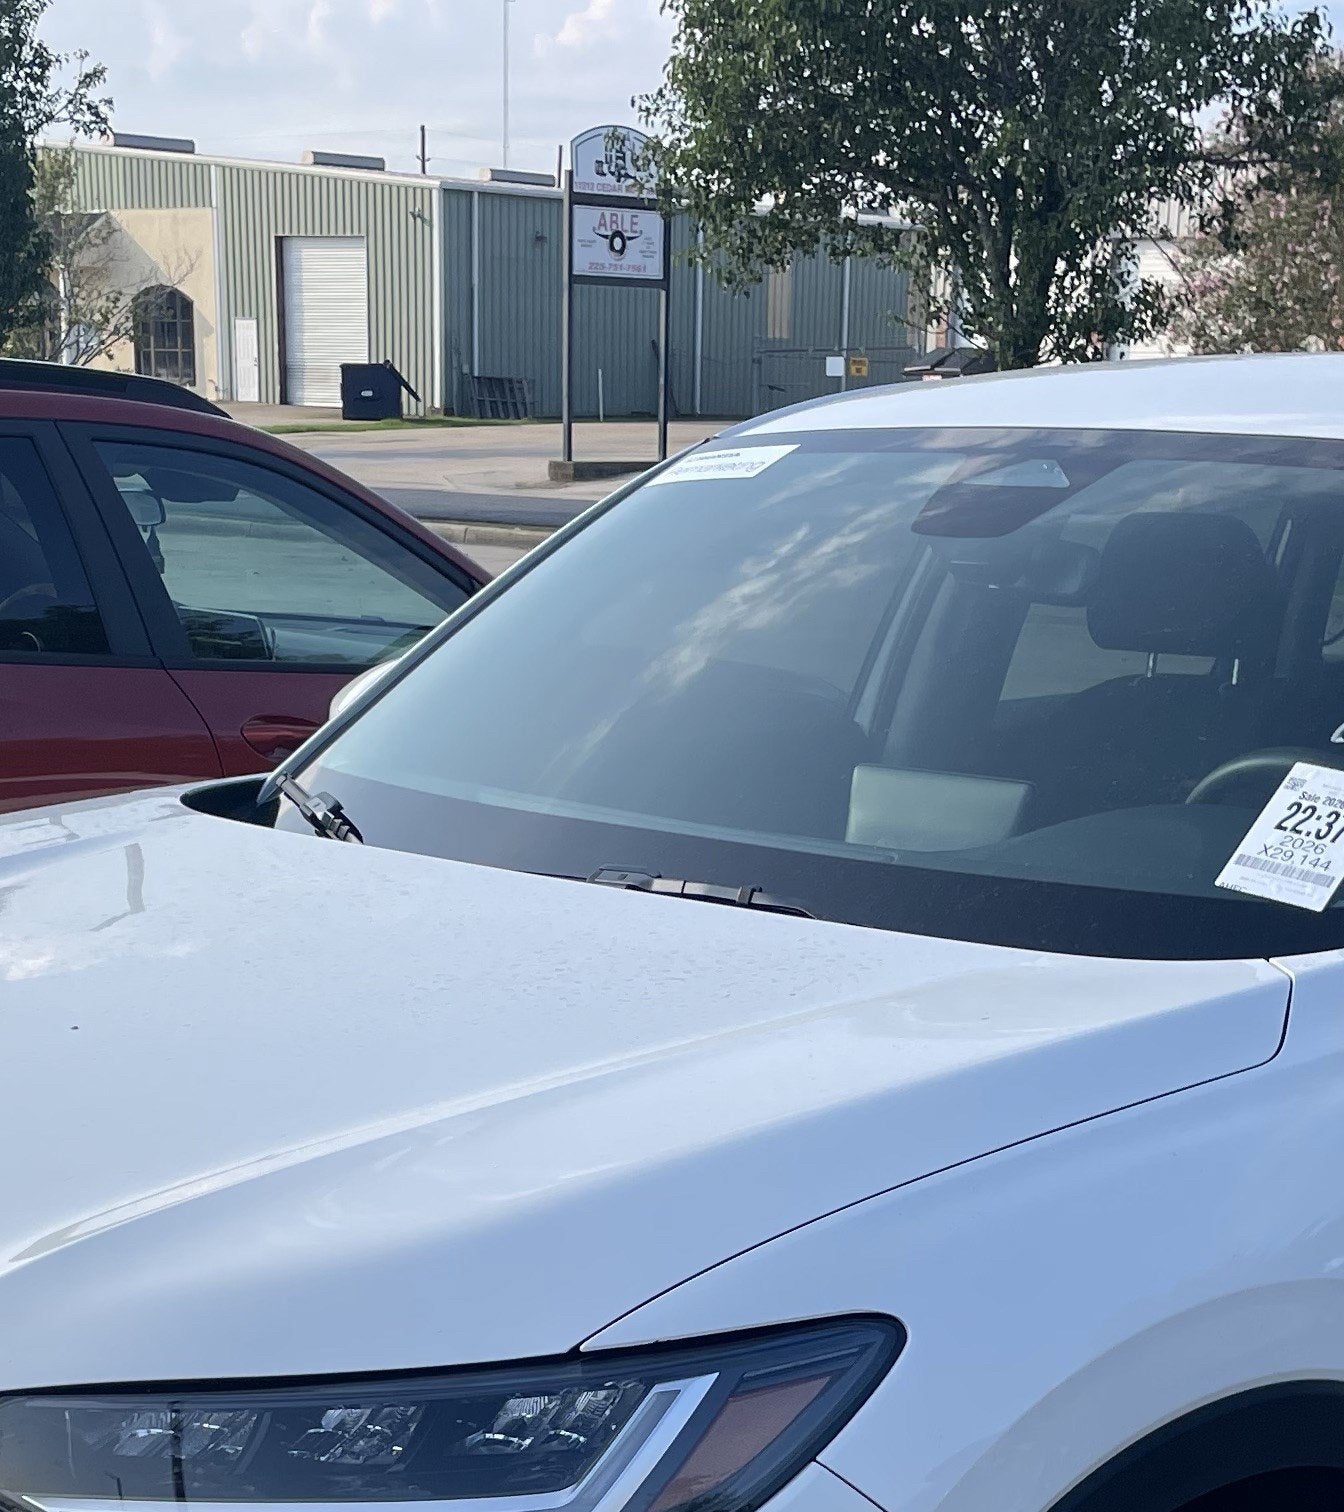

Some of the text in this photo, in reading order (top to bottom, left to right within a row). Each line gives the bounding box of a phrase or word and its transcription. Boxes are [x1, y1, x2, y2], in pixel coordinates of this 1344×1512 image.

[597, 211, 639, 234] ABLE
[1298, 790, 1321, 804] Sale
[1279, 835, 1327, 855] 2026
